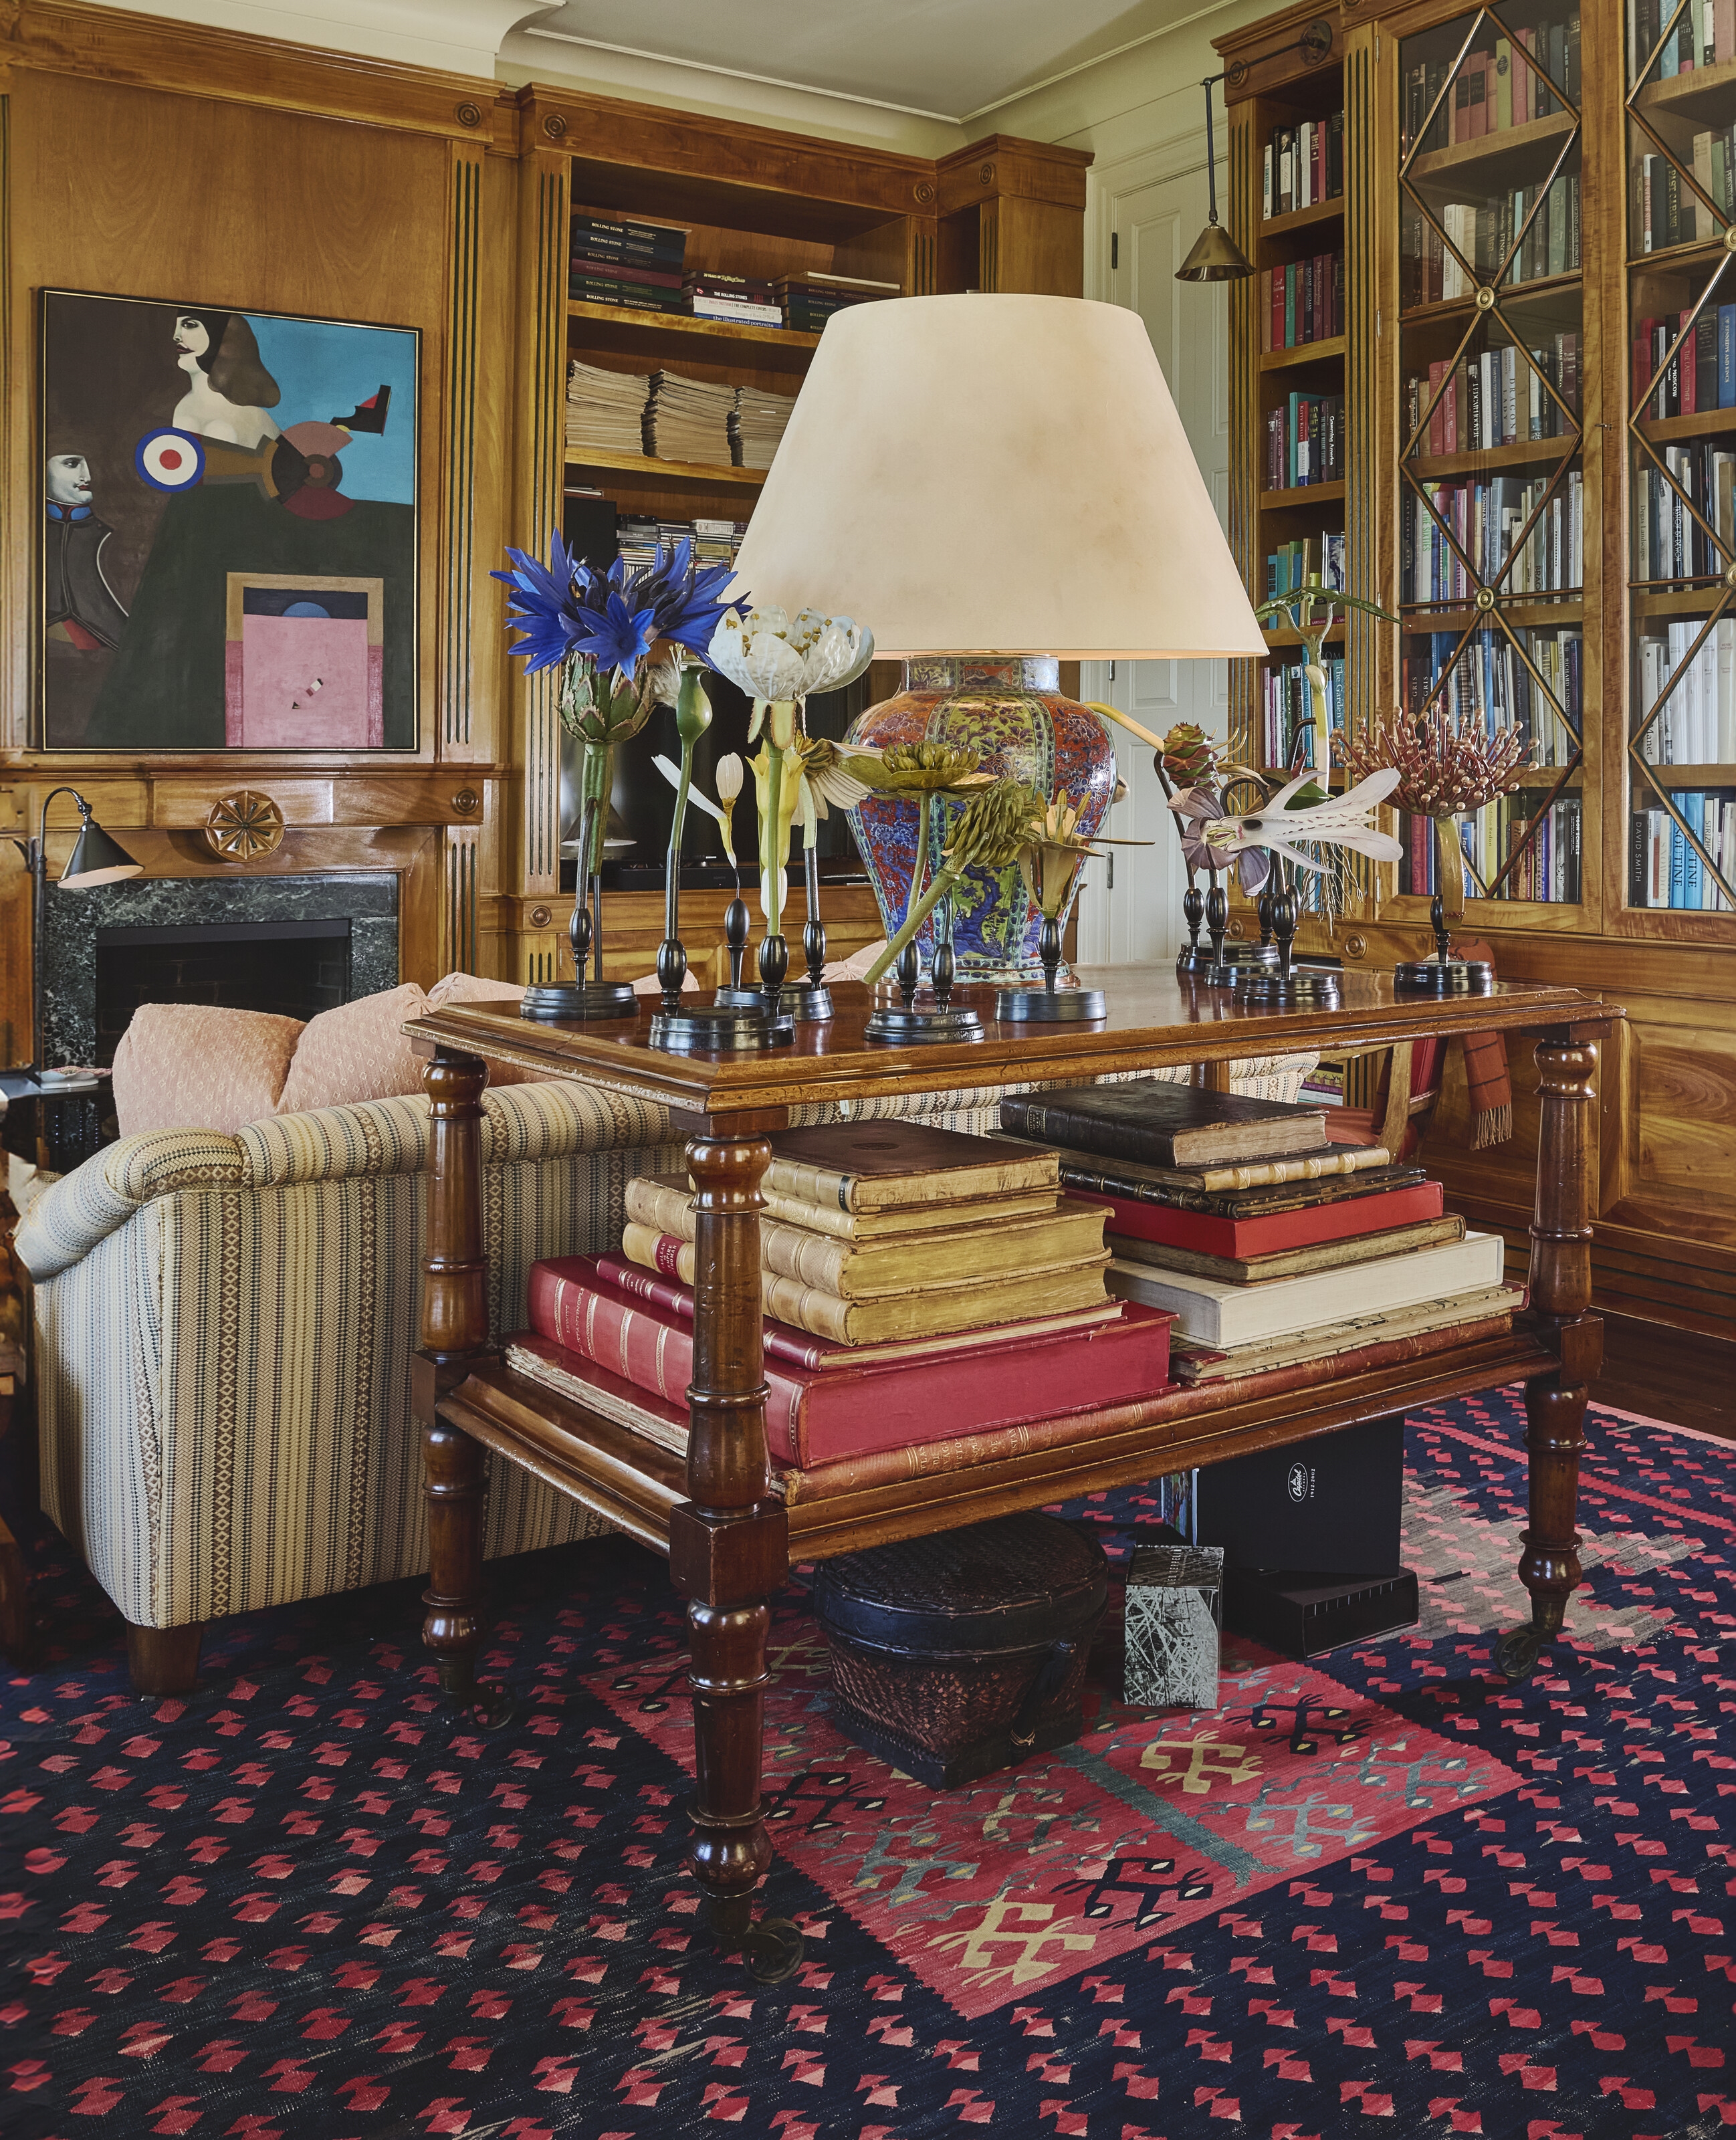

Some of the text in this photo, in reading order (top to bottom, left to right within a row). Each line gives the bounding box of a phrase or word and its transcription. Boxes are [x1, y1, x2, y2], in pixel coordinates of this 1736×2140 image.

[1668, 169, 1676, 227] PAST CARING
[592, 222, 609, 230] ROLLING
[590, 236, 608, 244] ROLLING
[723, 316, 750, 324] illustrated
[1422, 514, 1431, 552] THE SIXTIES
[1542, 652, 1551, 679] THEN
[1646, 724, 1654, 756] Manet
[1673, 828, 1683, 887] SOUTINE
[1293, 1469, 1303, 1497] Capitol
[1169, 1549, 1182, 1573] ZEPPELIN
